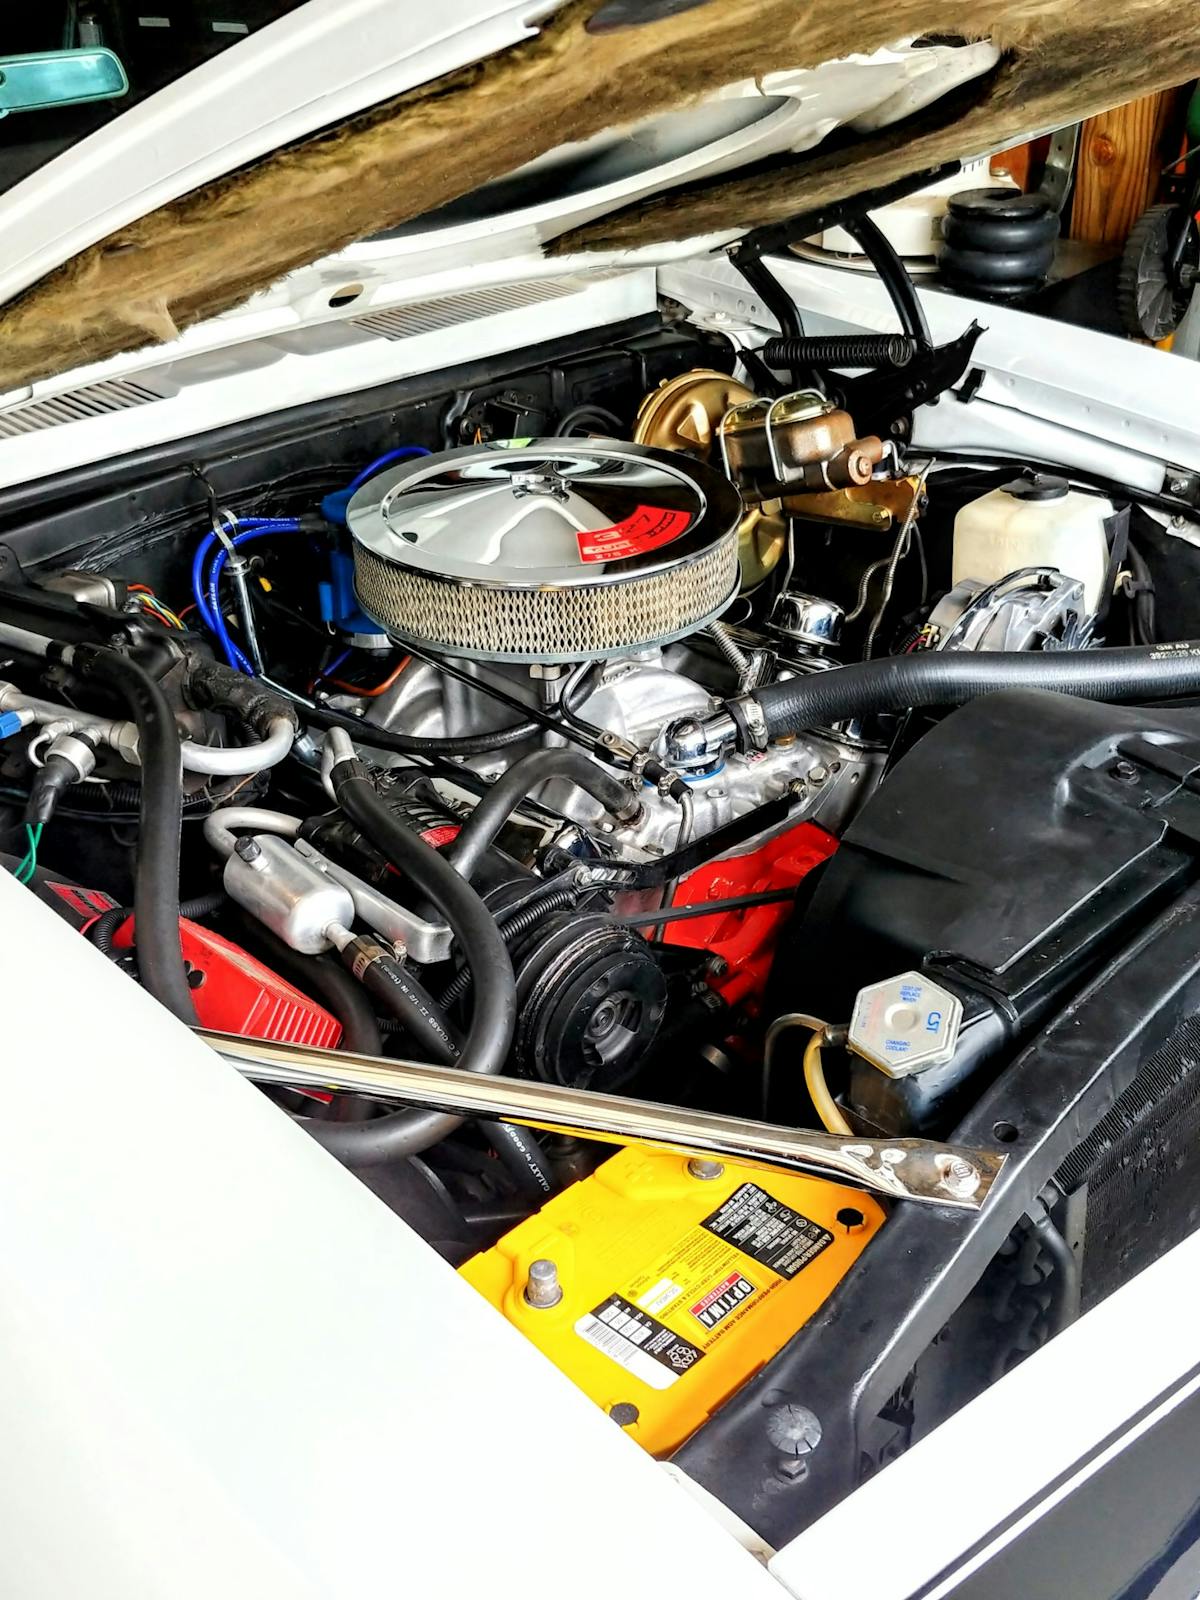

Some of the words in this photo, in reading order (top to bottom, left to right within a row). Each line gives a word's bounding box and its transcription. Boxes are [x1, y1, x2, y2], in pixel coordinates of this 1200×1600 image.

[428, 1016, 450, 1042] CLASS
[528, 1162, 550, 1192] GALAXY
[696, 1278, 755, 1326] OPTIMA
[698, 1280, 731, 1307] BATTERIES
